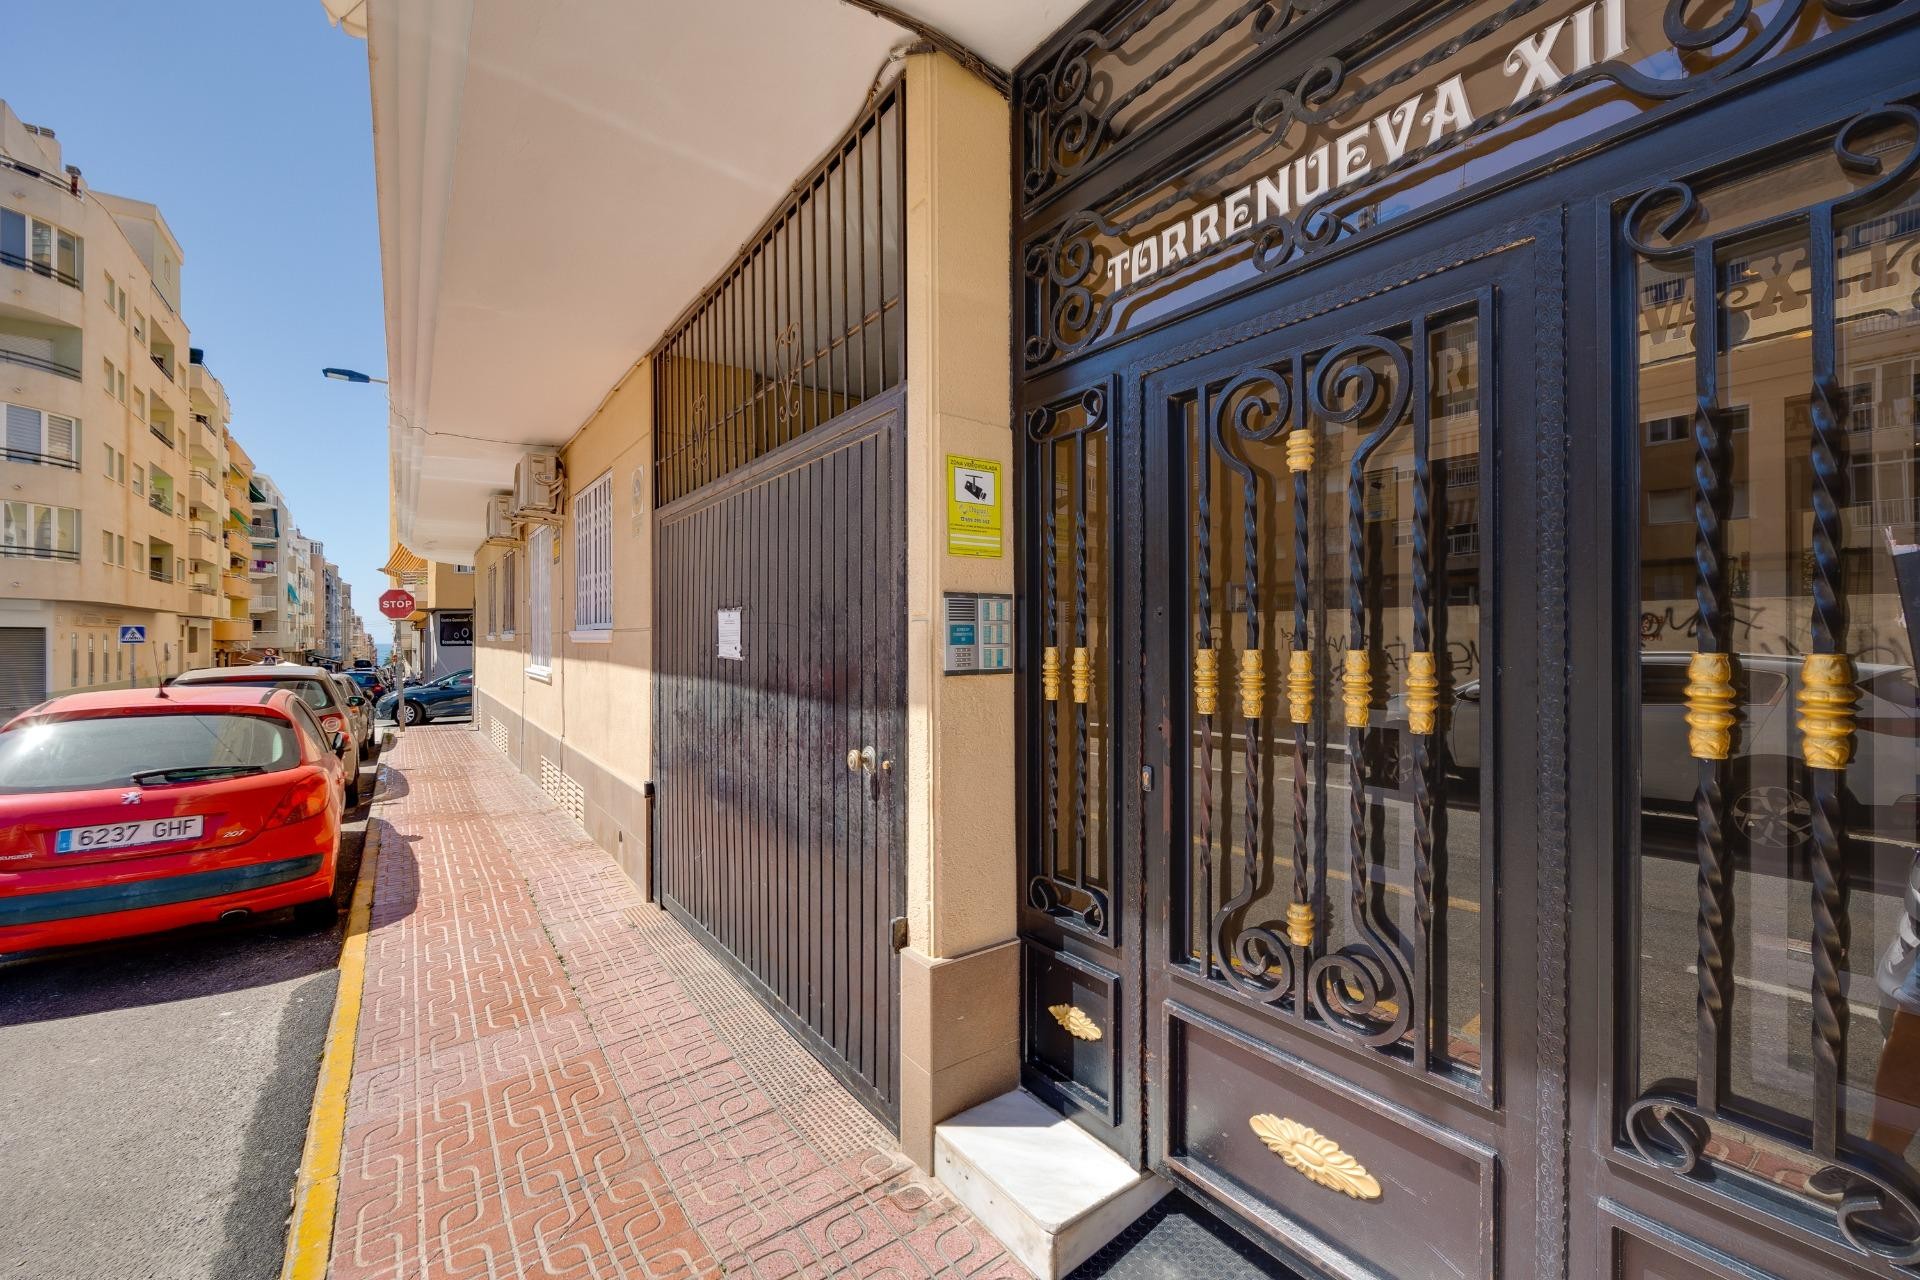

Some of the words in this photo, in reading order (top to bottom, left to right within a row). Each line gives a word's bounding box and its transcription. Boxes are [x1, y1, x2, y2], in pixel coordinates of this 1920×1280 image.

[1106, 73, 1475, 293] TORRENUEVA
[1503, 0, 1632, 107] XII
[382, 600, 412, 609] STOP
[79, 824, 141, 847] 6237
[152, 817, 197, 839] GHF
[223, 829, 247, 838] 207
[0, 851, 34, 861] EUGEOT
